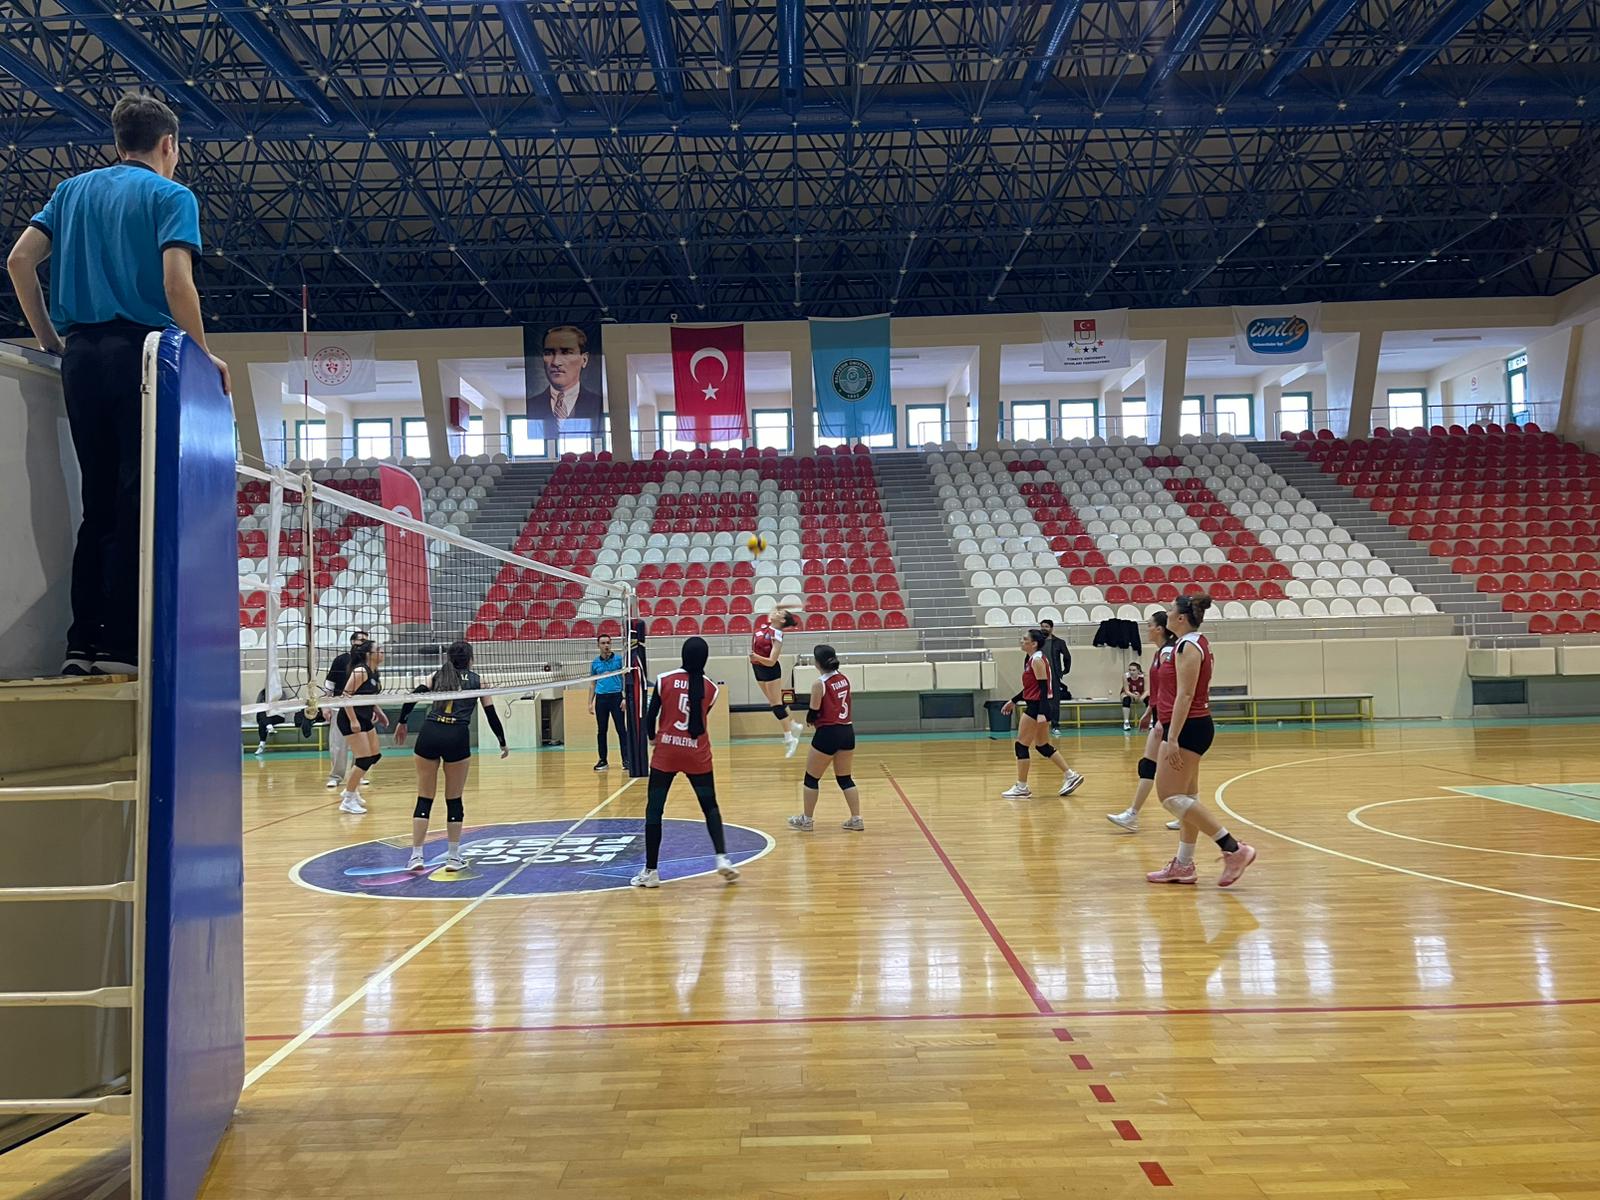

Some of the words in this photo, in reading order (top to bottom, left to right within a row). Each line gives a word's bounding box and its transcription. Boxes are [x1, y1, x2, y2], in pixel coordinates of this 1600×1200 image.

[837, 690, 849, 720] 3
[472, 836, 636, 847] FEST
[461, 844, 627, 855] SPOR
